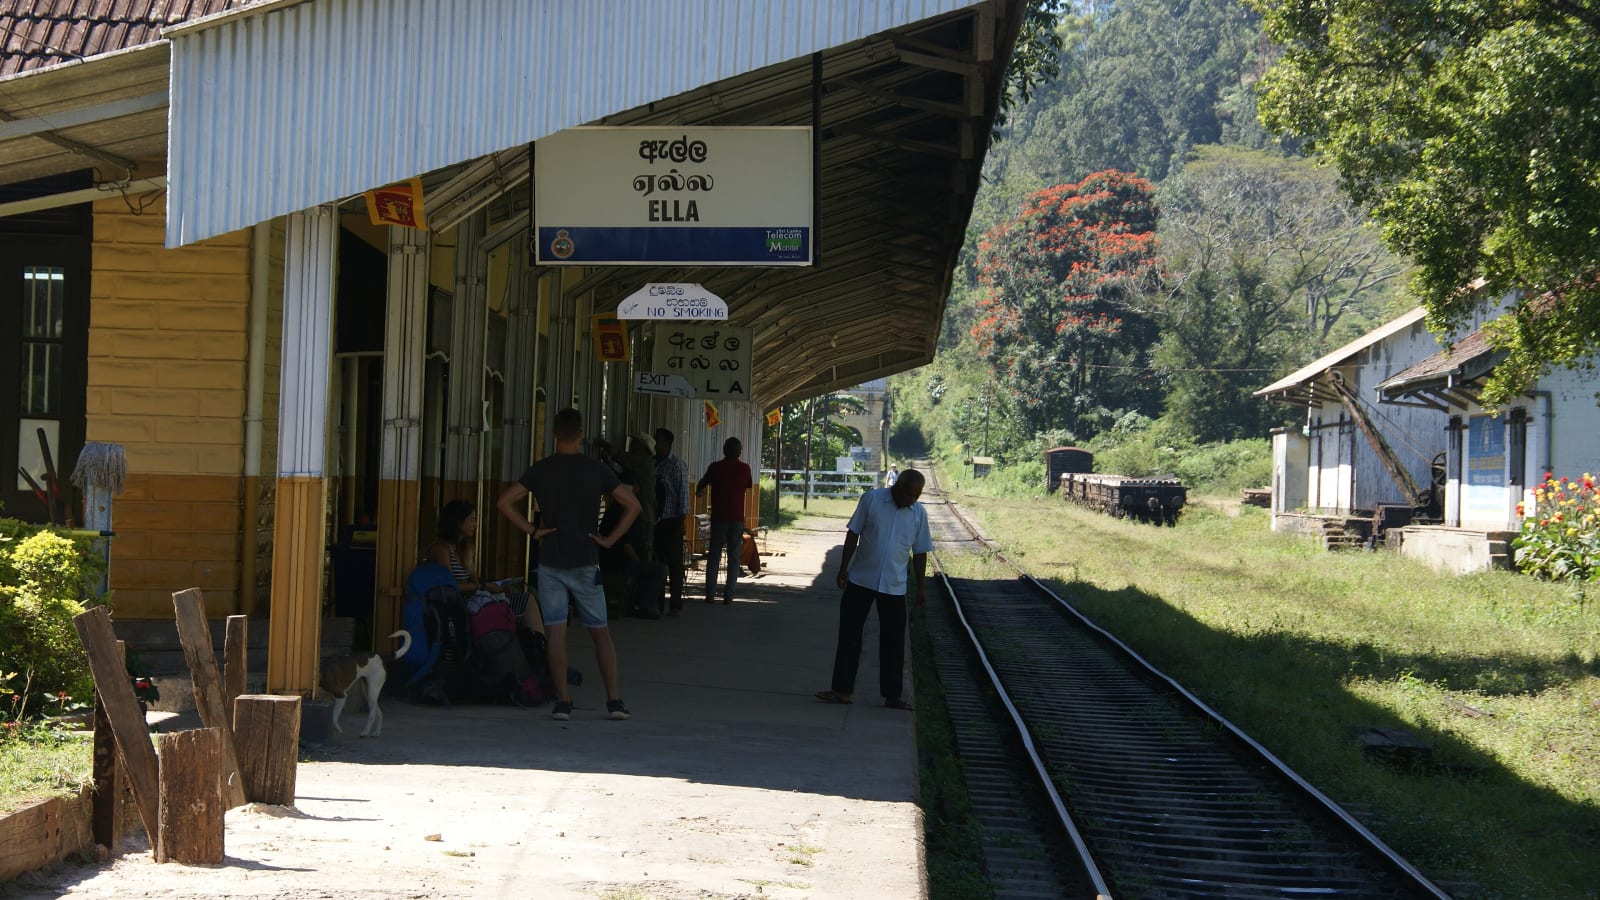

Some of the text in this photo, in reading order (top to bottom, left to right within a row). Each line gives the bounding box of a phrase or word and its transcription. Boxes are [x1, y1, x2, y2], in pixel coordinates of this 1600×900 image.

[639, 135, 708, 164] ඇල්ල
[633, 168, 714, 198] ஏல்ல
[648, 199, 700, 222] ELLA
[765, 230, 802, 239] Telecom
[647, 306, 724, 318] NO SMOKING
[640, 372, 670, 386] EXIT
